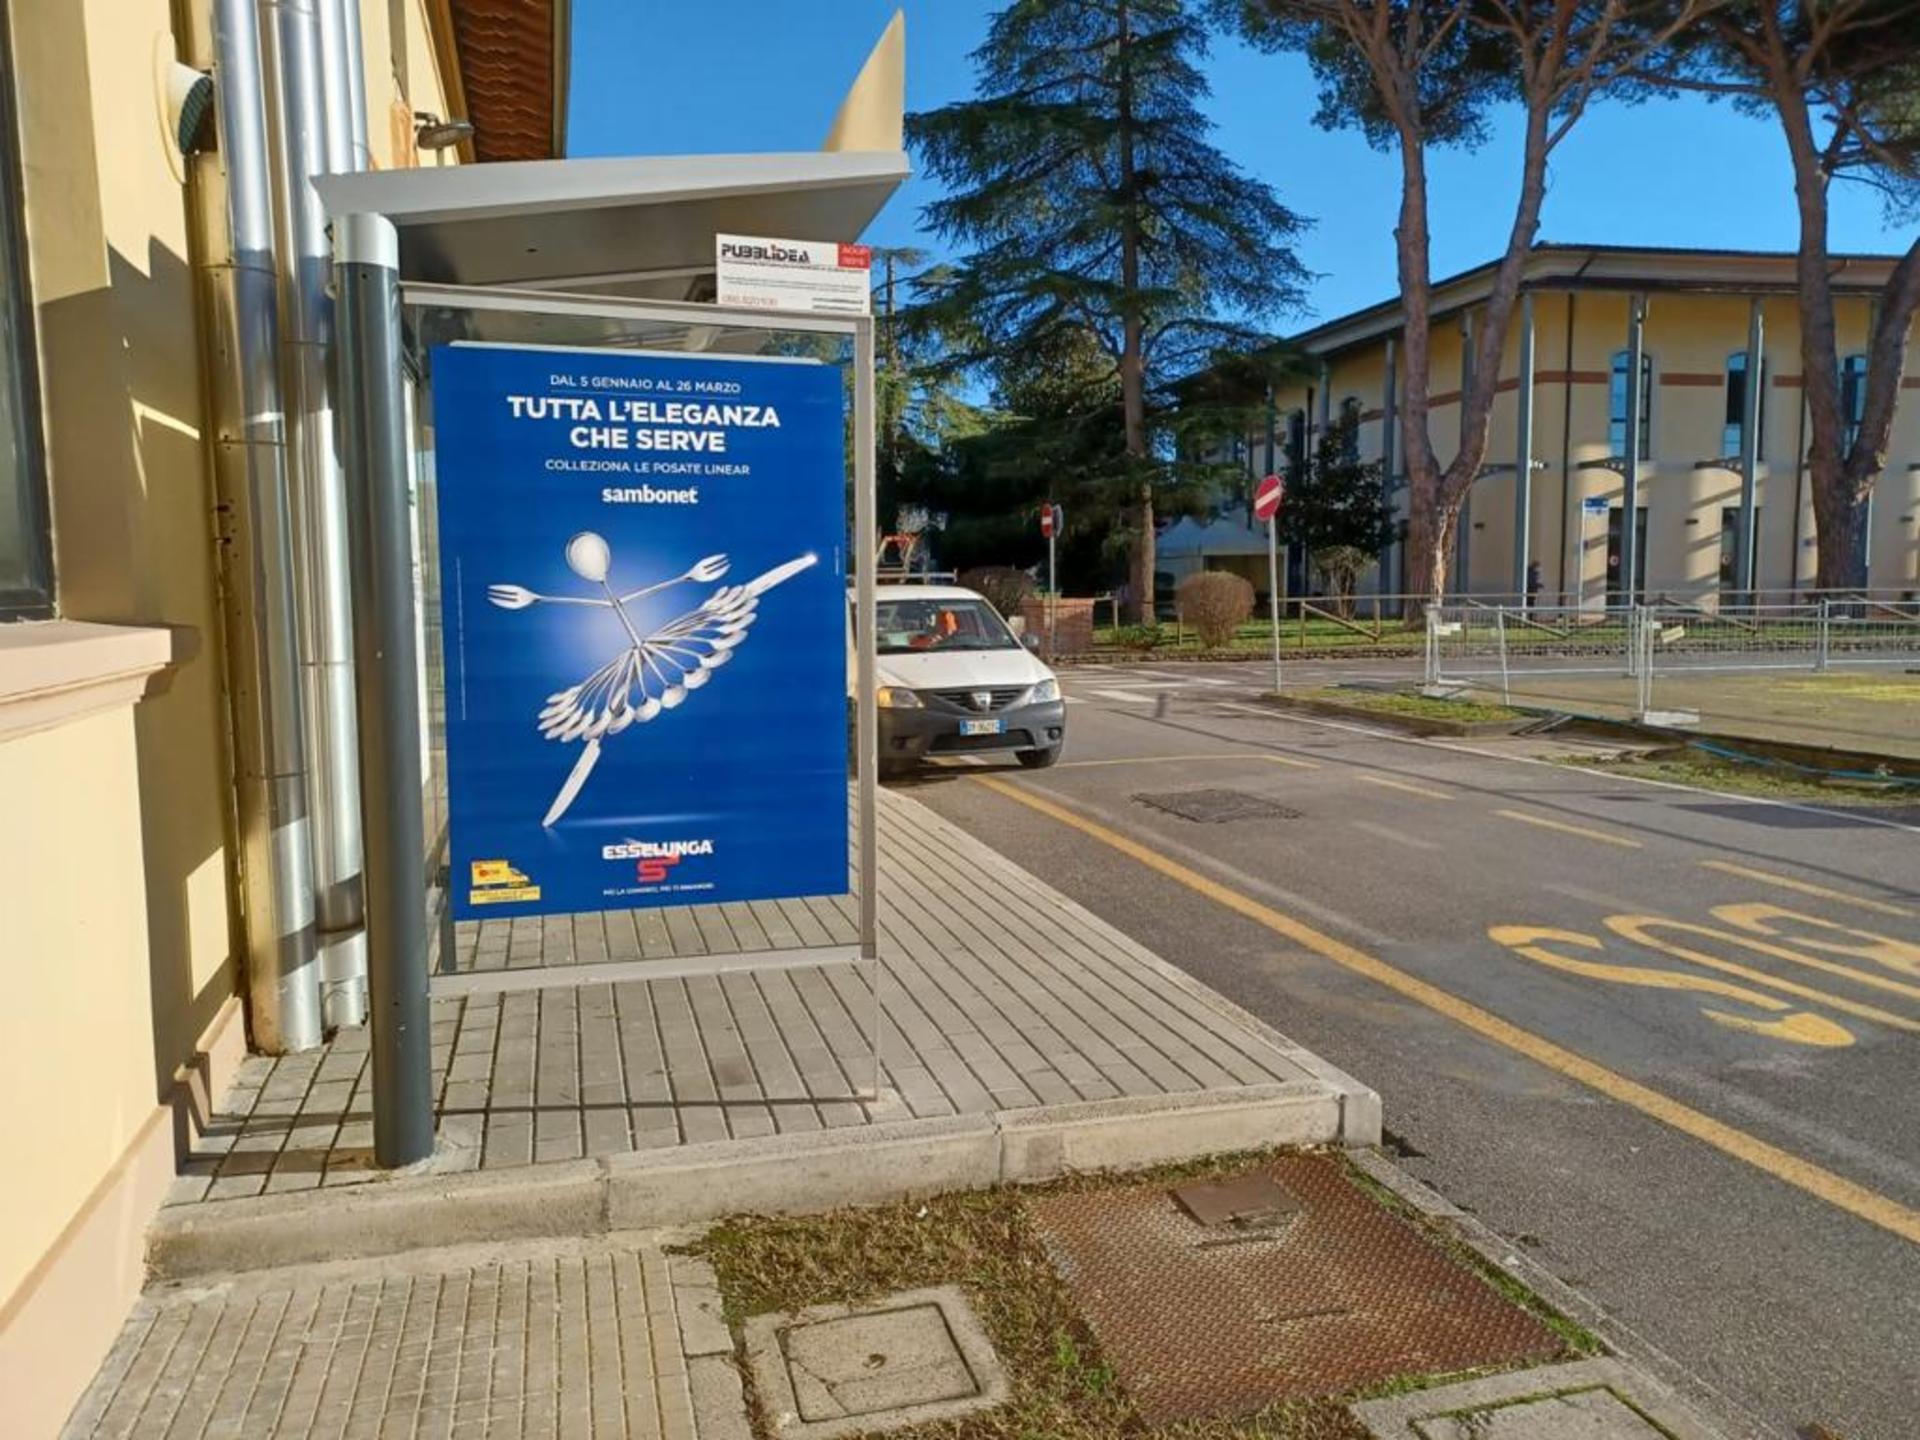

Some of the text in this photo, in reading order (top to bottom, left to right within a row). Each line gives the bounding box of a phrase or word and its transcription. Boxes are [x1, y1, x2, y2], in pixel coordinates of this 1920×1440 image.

[550, 374, 741, 394] DAL 5 GENNAIO AL 26 MARZO
[507, 396, 602, 422] TUTTA
[570, 427, 726, 452] CHE SERVE
[545, 459, 750, 475] COLLEZIONA LE POSATE LINEAR
[602, 484, 699, 504] sambonet
[602, 839, 713, 860] ESSELUNGA
